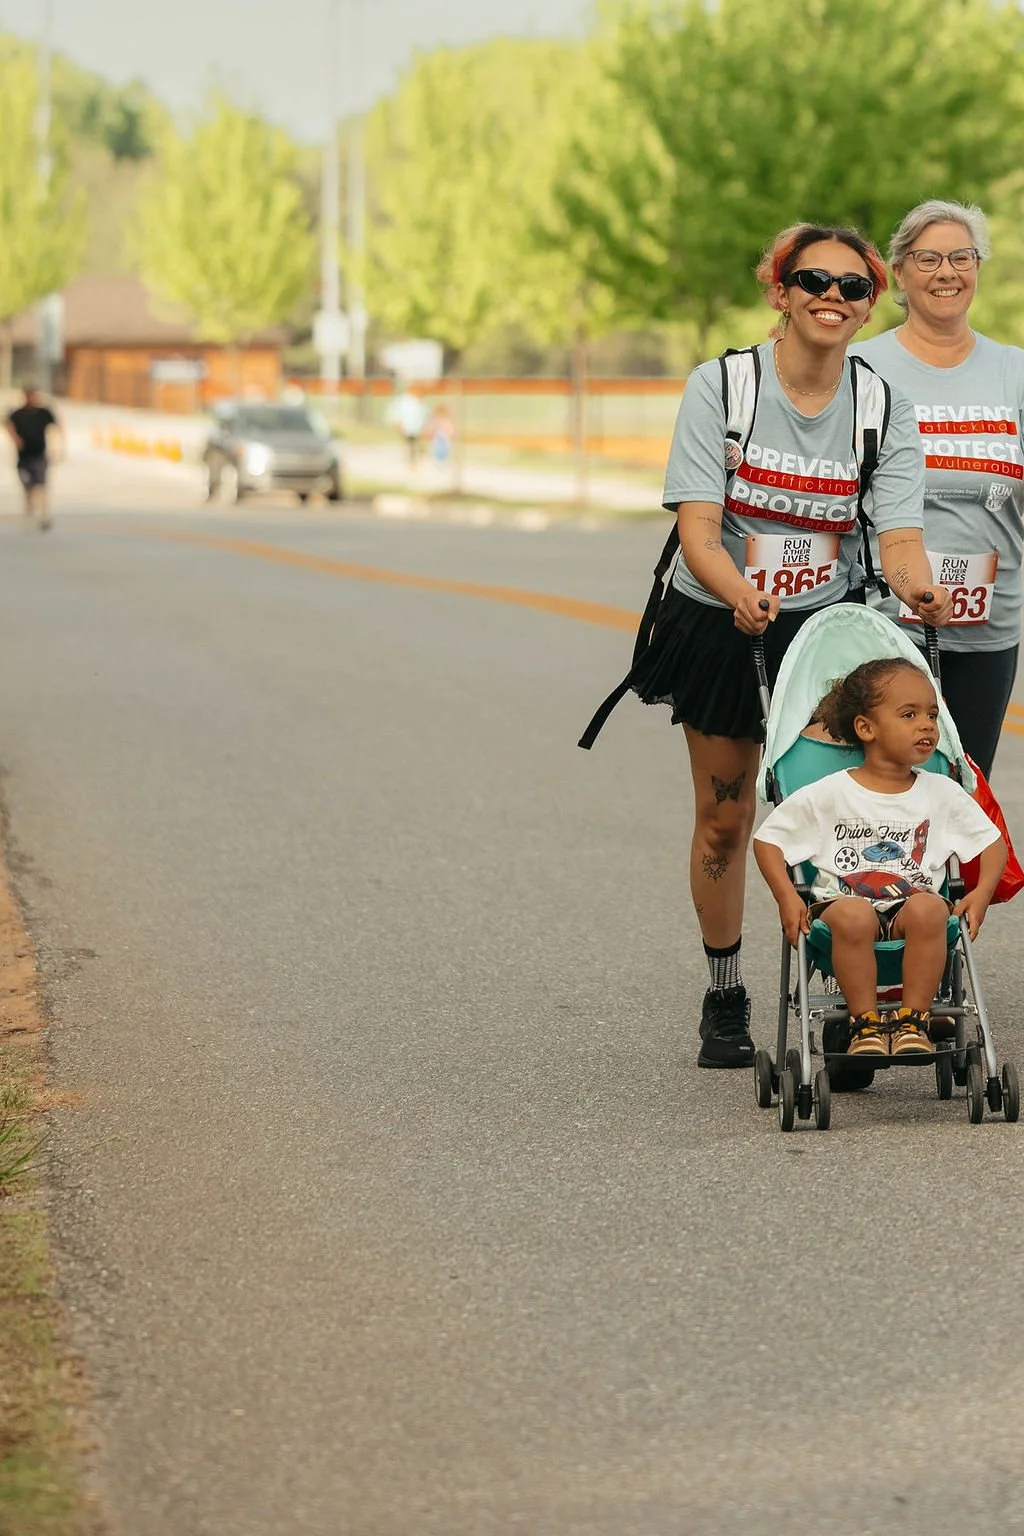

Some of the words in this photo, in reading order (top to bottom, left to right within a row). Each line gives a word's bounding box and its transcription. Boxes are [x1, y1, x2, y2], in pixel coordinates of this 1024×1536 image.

[914, 404, 1013, 422] REVENT
[924, 420, 1008, 435] afficking
[921, 438, 1019, 463] ROTECT
[746, 443, 858, 481] PREVENT
[935, 457, 1021, 477] Vulnerable
[783, 539, 812, 550] RUN
[782, 554, 810, 563] LIVES
[942, 558, 969, 568] RUN
[939, 573, 966, 581] LIVES
[834, 823, 874, 841] Drive
